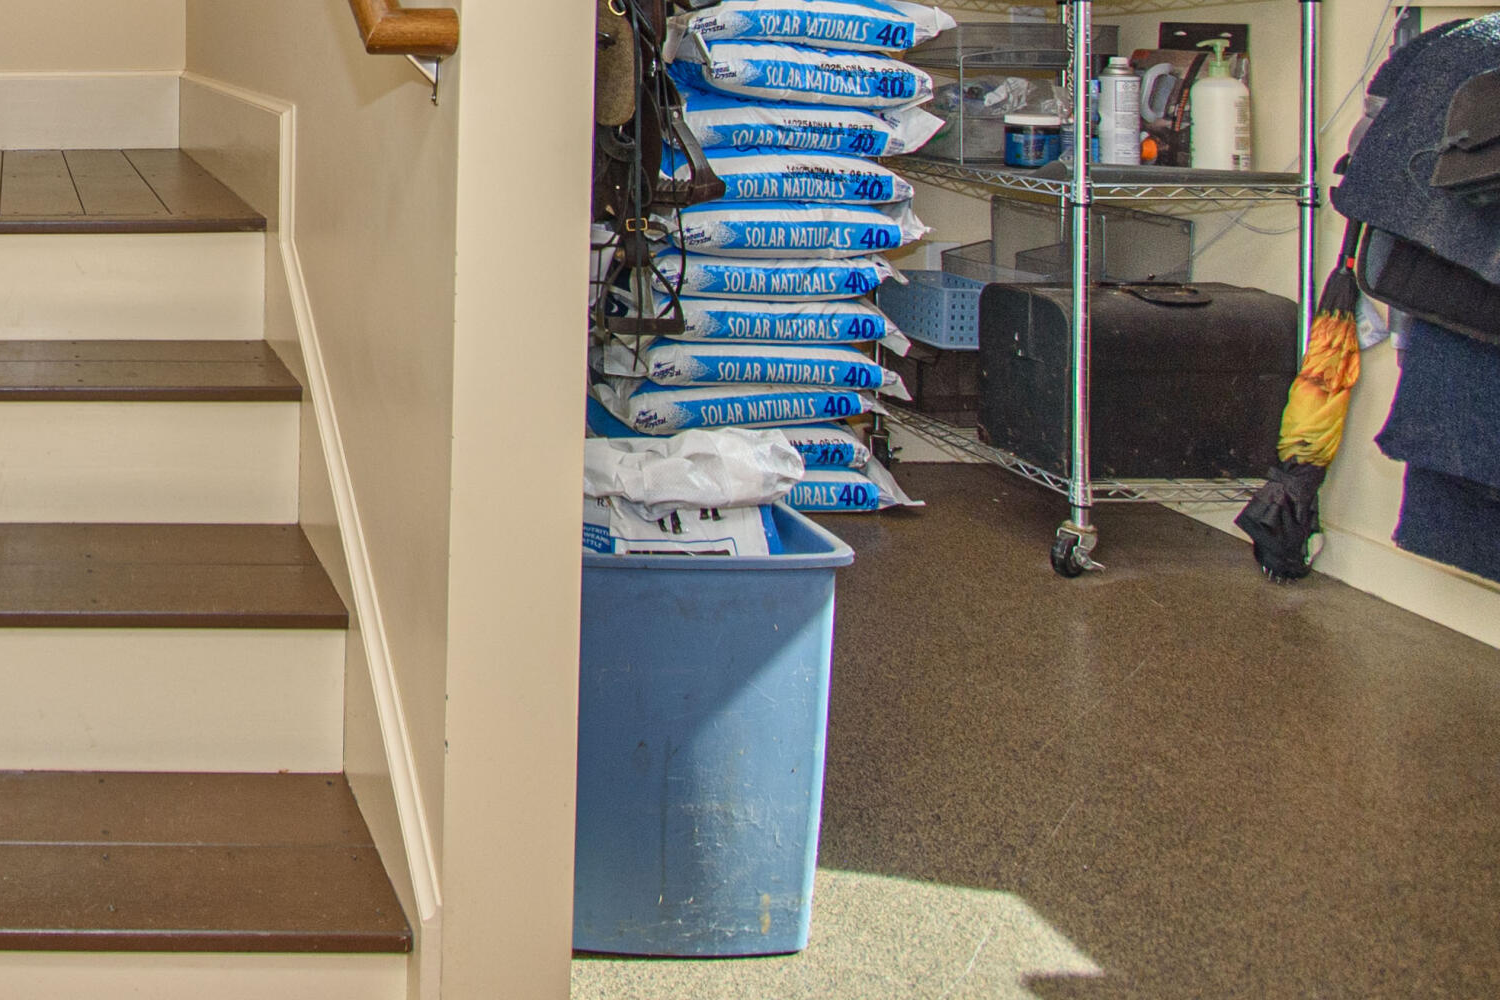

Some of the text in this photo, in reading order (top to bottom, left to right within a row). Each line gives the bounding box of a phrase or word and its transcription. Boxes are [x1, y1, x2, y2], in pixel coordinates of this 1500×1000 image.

[759, 15, 800, 35] SOLAR
[877, 24, 907, 46] 40
[764, 65, 801, 87] SOLAR
[806, 68, 870, 95] NATURALS
[876, 76, 904, 98] 40
[732, 129, 773, 147] SOLAR
[778, 130, 841, 150] NATURALS
[849, 133, 875, 153] 40
[736, 179, 778, 198] SOLAR
[782, 178, 845, 198] NATURALS
[854, 180, 884, 200] 40
[744, 227, 785, 247] SOLAR
[859, 228, 890, 249] 40
[723, 271, 836, 293] SOLAR NATURALS
[844, 272, 870, 294] 40
[728, 317, 839, 339] SOLAR NATURALS
[848, 318, 875, 339] 40
[717, 362, 835, 384] SOLAR NATURALS
[844, 366, 871, 388] 40
[700, 398, 816, 425] SOLAR NATURALS
[823, 396, 851, 416] 40
[784, 486, 838, 506] TURALS
[839, 485, 867, 506] 40
